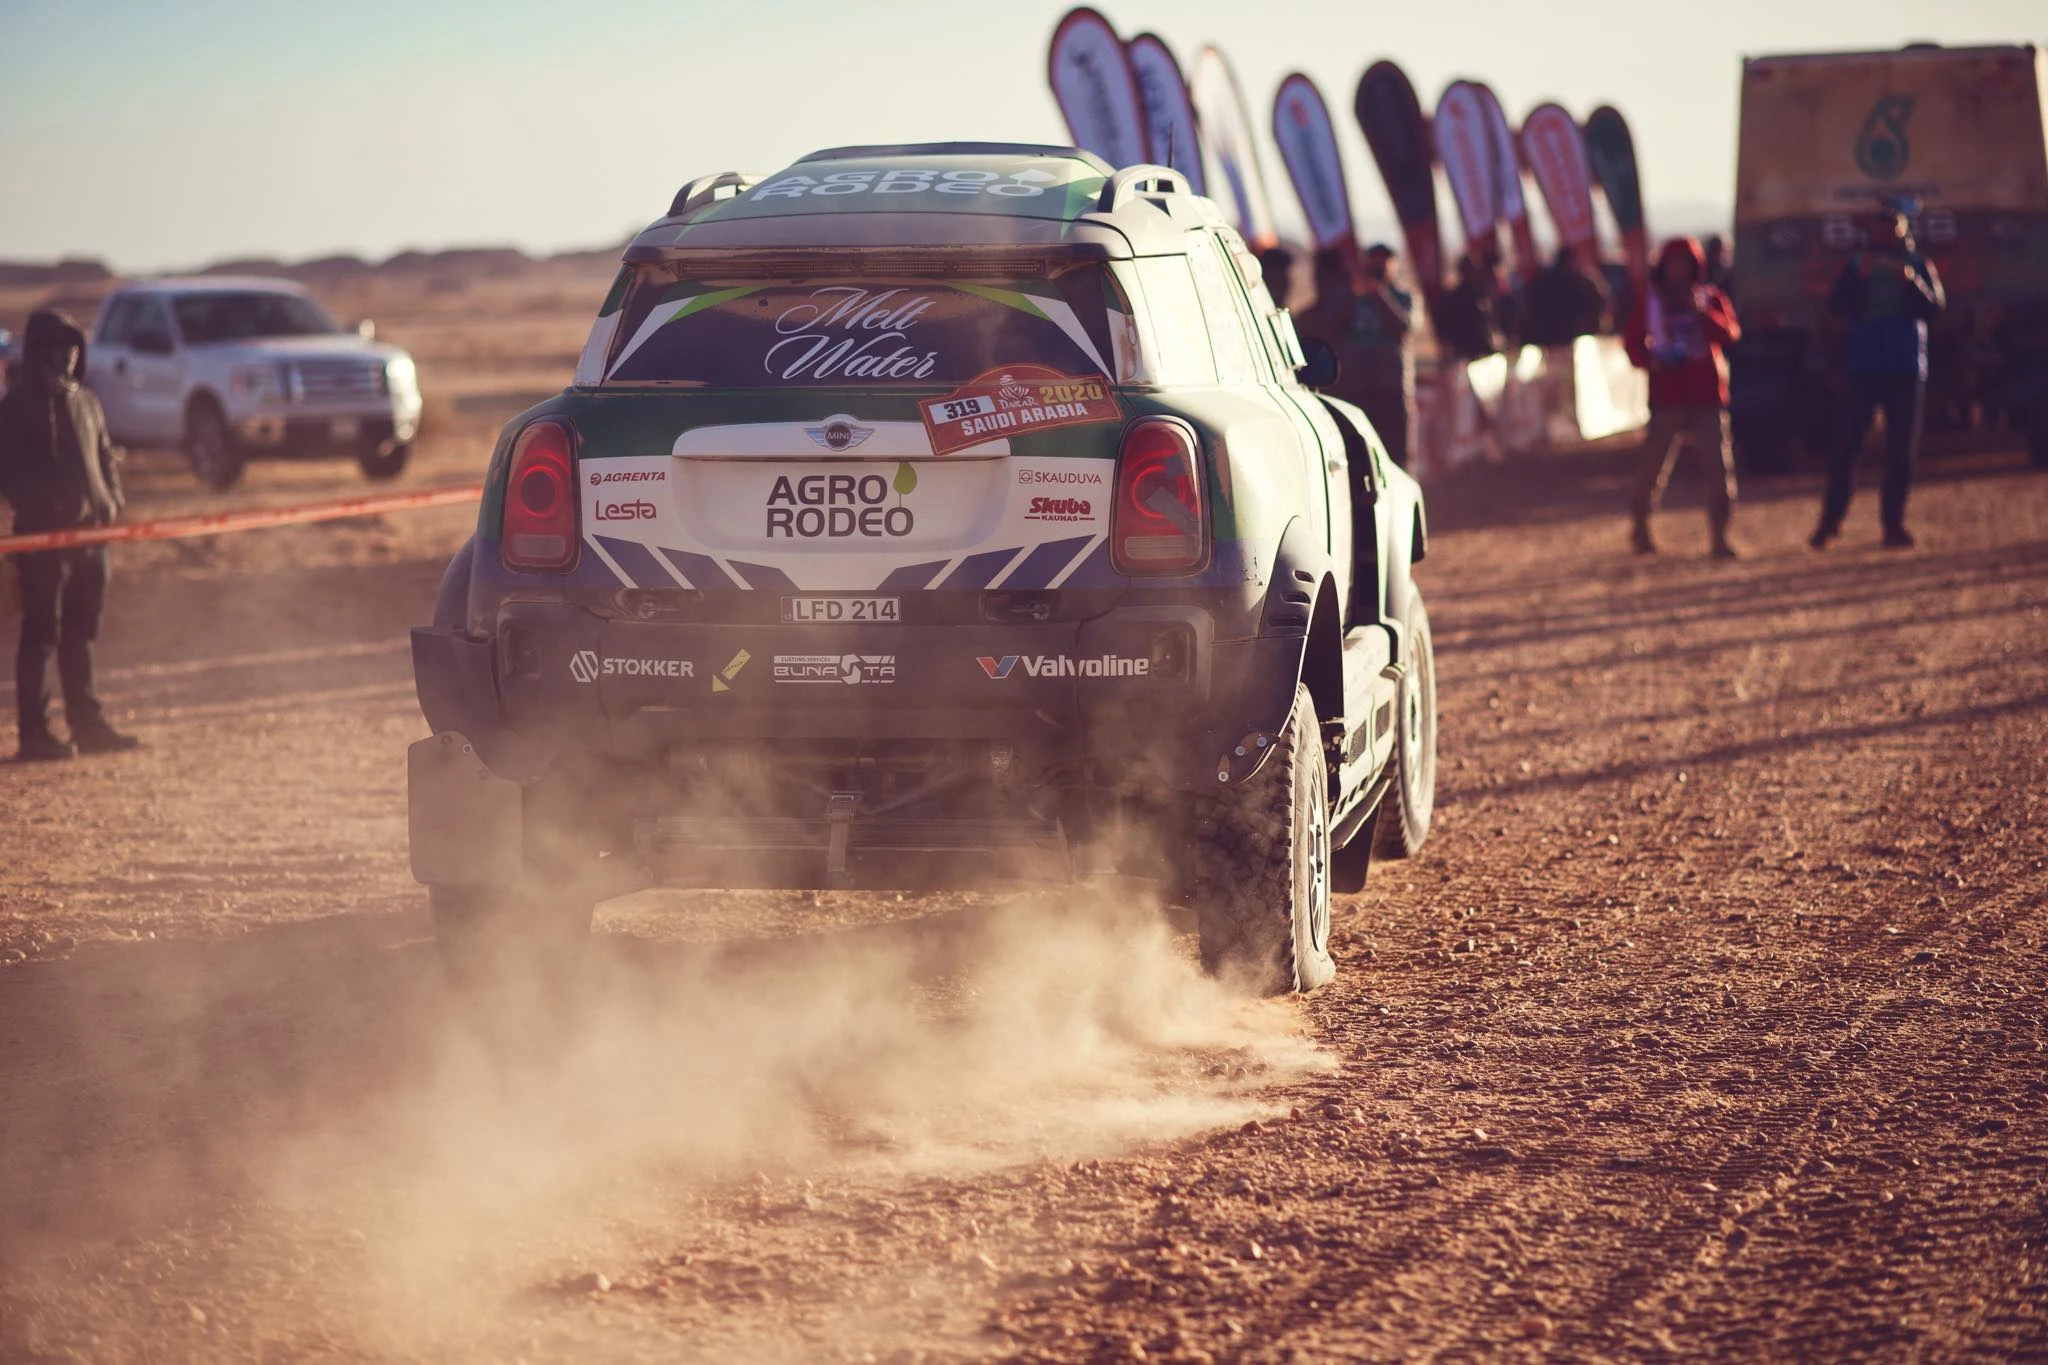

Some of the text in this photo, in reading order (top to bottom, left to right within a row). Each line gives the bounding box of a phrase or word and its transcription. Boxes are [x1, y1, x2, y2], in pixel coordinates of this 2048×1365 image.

[753, 169, 999, 188] AGRO
[751, 180, 1044, 200] RODEO
[775, 286, 937, 334] Melt
[765, 332, 938, 379] Water
[999, 396, 1042, 410] DAKAR
[1040, 383, 1104, 404] 2020
[943, 399, 981, 420] 319
[961, 402, 1089, 436] SAUDI ARABIA
[827, 431, 850, 440] MINI
[603, 471, 666, 482] AGRENTA
[1034, 471, 1102, 484] SKAUDUVA
[766, 475, 888, 506] AGRO
[595, 498, 656, 520] Lesta
[766, 507, 914, 537] RODEO
[796, 600, 897, 620] LFD 214
[602, 658, 695, 678] STOKKER
[1021, 654, 1149, 677] Valvoline
